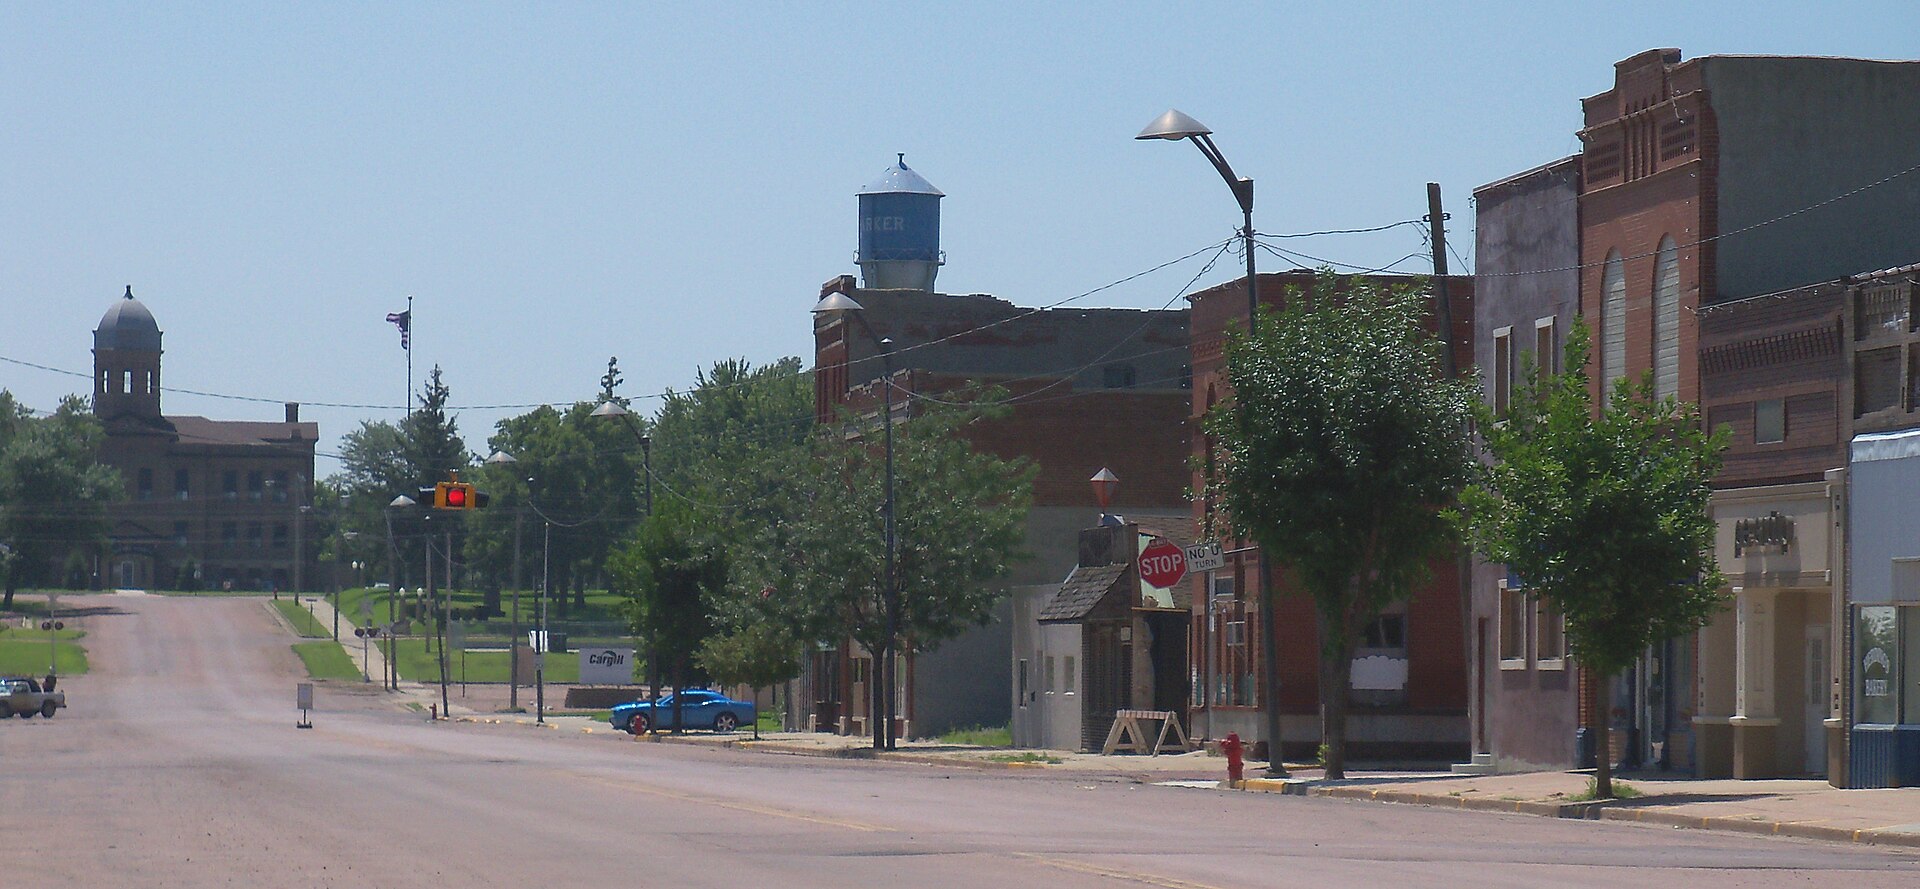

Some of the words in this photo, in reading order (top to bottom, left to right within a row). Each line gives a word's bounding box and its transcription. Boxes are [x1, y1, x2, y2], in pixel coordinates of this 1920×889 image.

[1189, 549, 1205, 560] NO
[1211, 546, 1219, 555] U
[1142, 554, 1183, 576] STOP
[1195, 559, 1217, 568] TURN
[589, 652, 625, 667] Cargill
